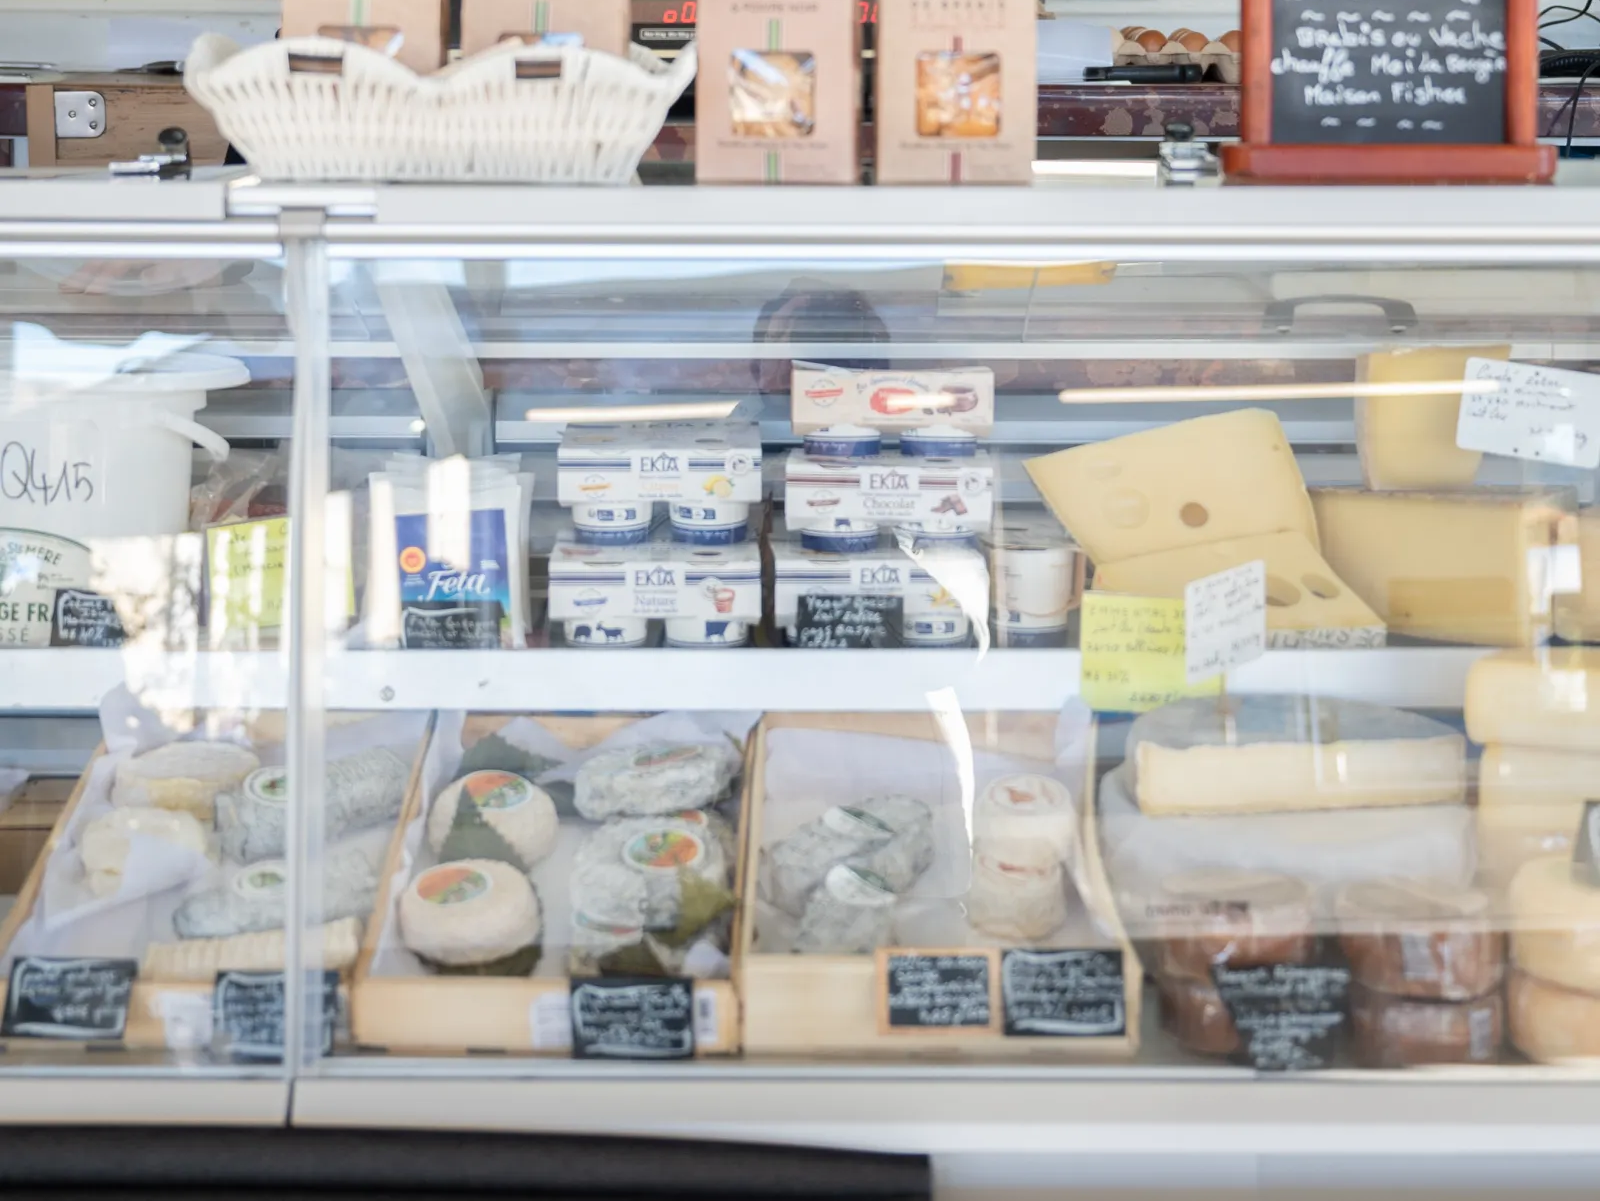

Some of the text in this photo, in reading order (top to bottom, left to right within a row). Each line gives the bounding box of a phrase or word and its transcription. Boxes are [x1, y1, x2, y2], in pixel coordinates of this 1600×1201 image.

[1295, 19, 1386, 48] Brebis
[1392, 31, 1421, 48] ou
[1304, 83, 1382, 106] Maison
[640, 453, 679, 472] EKIA
[869, 470, 909, 490] EKIA
[862, 498, 915, 510] Chocolat
[634, 566, 676, 586] EKIA
[860, 564, 900, 584] EKIA
[426, 569, 490, 601] Feta
[634, 594, 676, 606] Nature
[27, 602, 53, 622] FR
